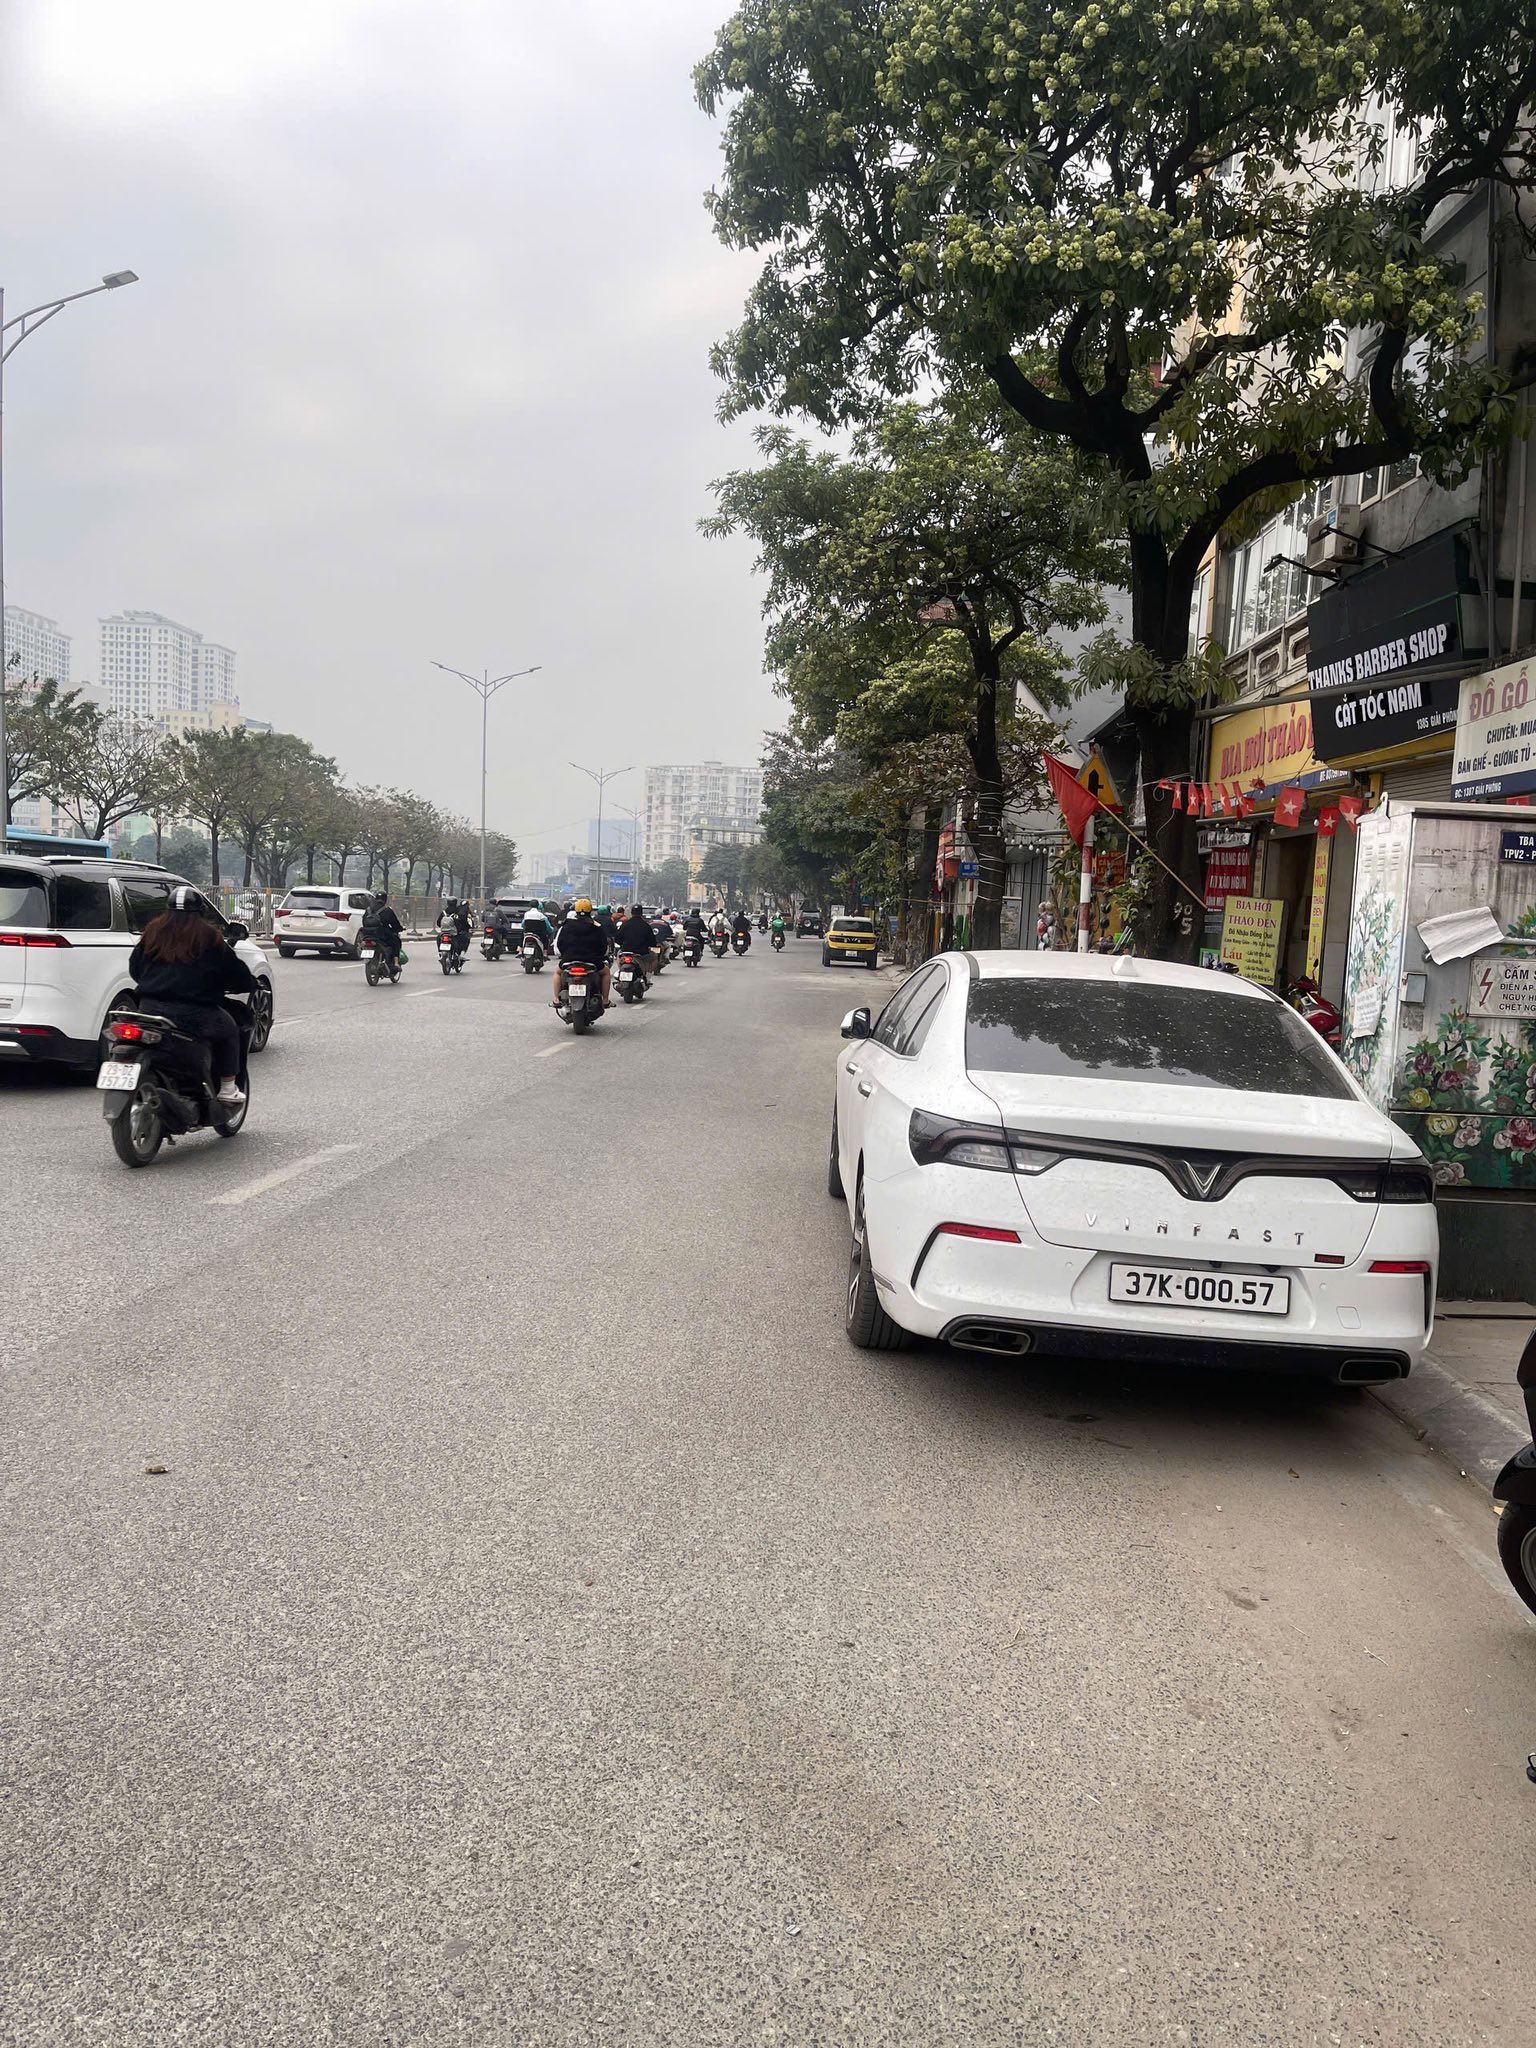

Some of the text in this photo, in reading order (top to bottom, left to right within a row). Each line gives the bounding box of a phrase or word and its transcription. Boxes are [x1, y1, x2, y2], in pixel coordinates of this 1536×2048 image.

[1308, 623, 1447, 691] THANKS BARBER SHOP
[1359, 689, 1386, 722] TÓC
[1387, 682, 1422, 715] NAM
[1469, 665, 1529, 721] ĐỒ GỖ
[1416, 716, 1429, 730] 1385
[1442, 707, 1457, 724] PHÓN
[1220, 742, 1242, 780] BIA
[1244, 726, 1266, 772] HƠI
[1267, 703, 1306, 763] THẢO
[1486, 722, 1518, 744] CHUYÊN:
[1457, 759, 1471, 774] BÀN
[1473, 751, 1488, 770] GHẾ
[1493, 749, 1518, 768] GƯƠNG
[1521, 743, 1530, 762] TỦ
[1519, 835, 1534, 846] TBA
[1504, 848, 1524, 859] TPV2
[1236, 900, 1251, 910] BIA
[1254, 901, 1272, 913] HƠI
[1257, 917, 1277, 929] ĐEN
[1504, 965, 1530, 980] CẤM
[1502, 993, 1526, 1001] NGUY
[1085, 1213, 1304, 1246] VINFAST
[1125, 1271, 1274, 1307] 37K-000.57
